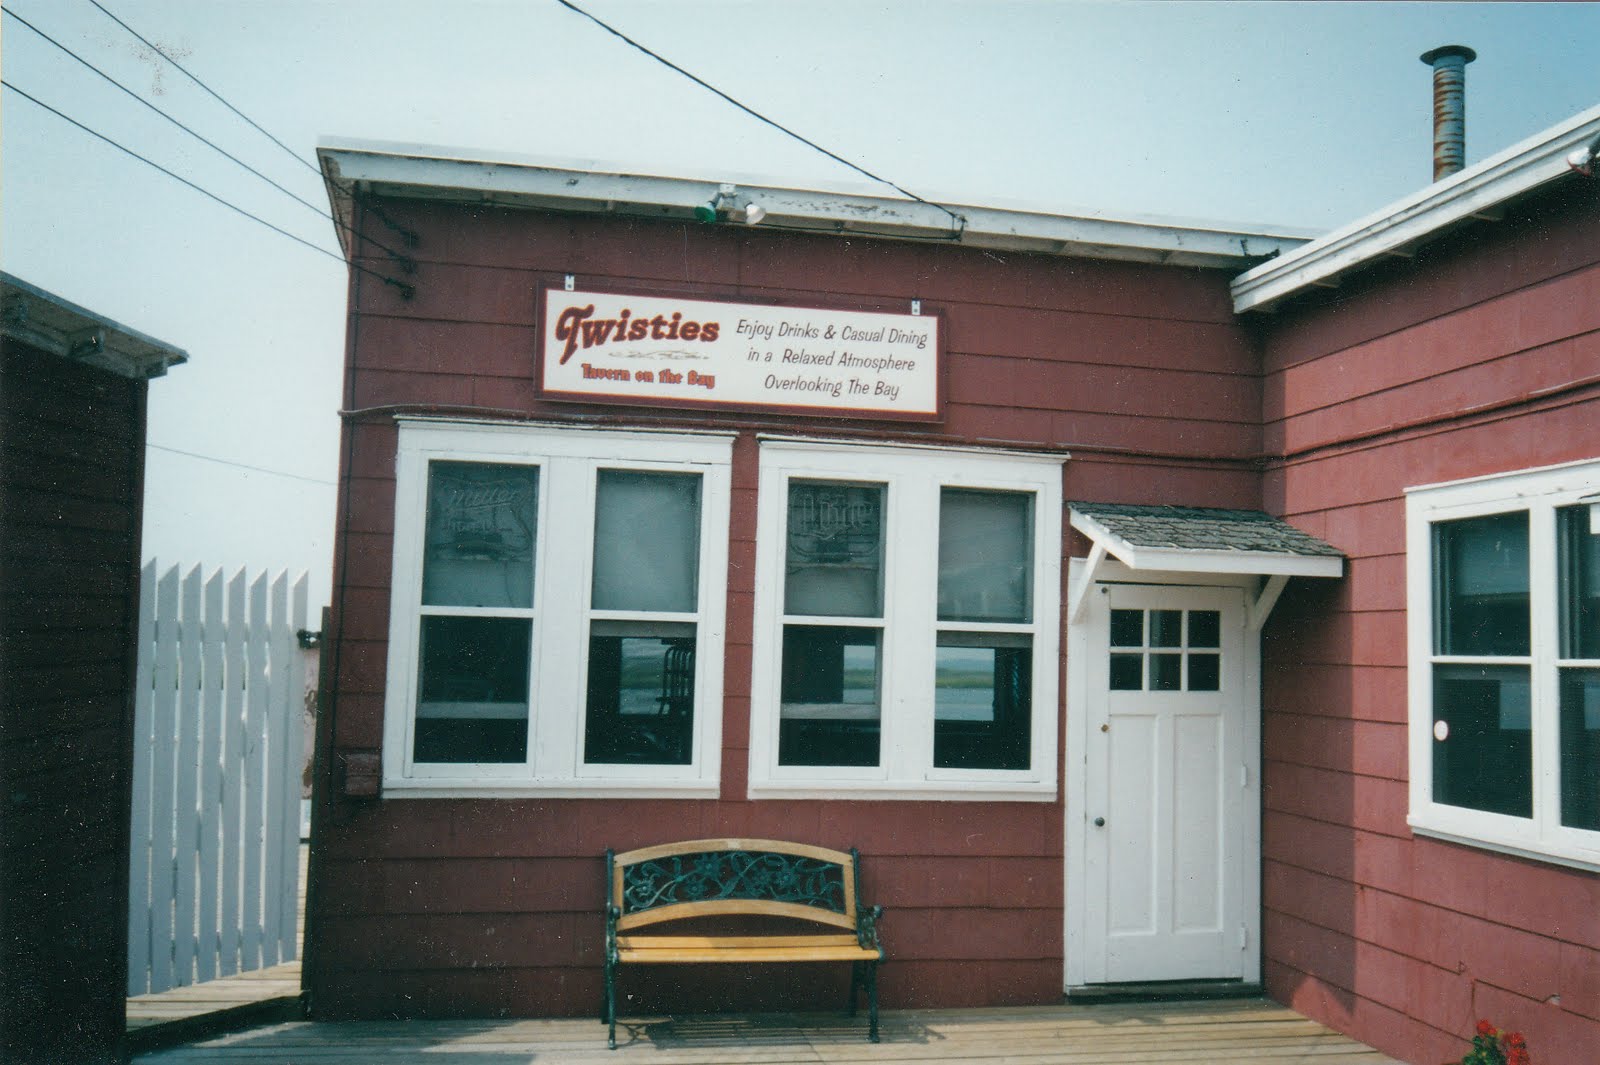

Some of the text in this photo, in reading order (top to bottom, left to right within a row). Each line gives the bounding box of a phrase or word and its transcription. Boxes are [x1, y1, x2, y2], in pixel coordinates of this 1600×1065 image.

[555, 303, 720, 365] Twisties
[736, 318, 928, 349] Enjoy Drinks & Casual Dining
[747, 347, 915, 373] in a Relaxed Atmosphere
[581, 363, 716, 390] Tavern on the Bay
[764, 374, 900, 400] Overlooking The Bay
